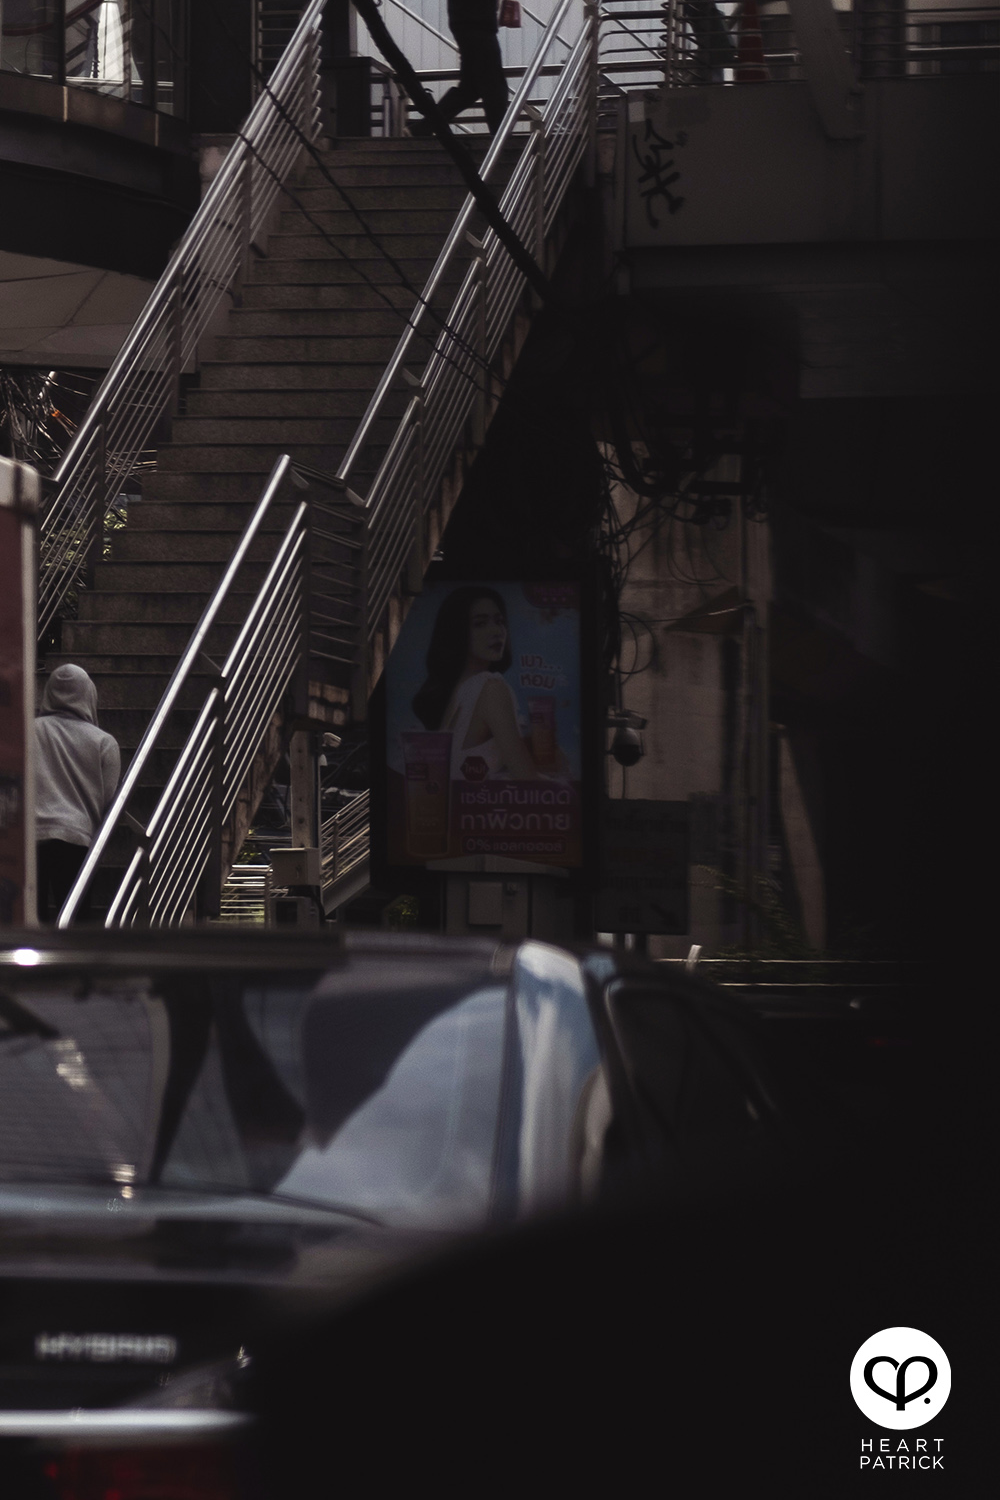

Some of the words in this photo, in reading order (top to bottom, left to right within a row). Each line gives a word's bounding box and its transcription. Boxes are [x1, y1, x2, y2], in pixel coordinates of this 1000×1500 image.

[520, 673, 556, 690] หอม
[459, 784, 572, 805] เซรั่มกันแดด
[459, 807, 572, 831] ทาผิวกาย
[34, 1332, 179, 1362] HYBRID
